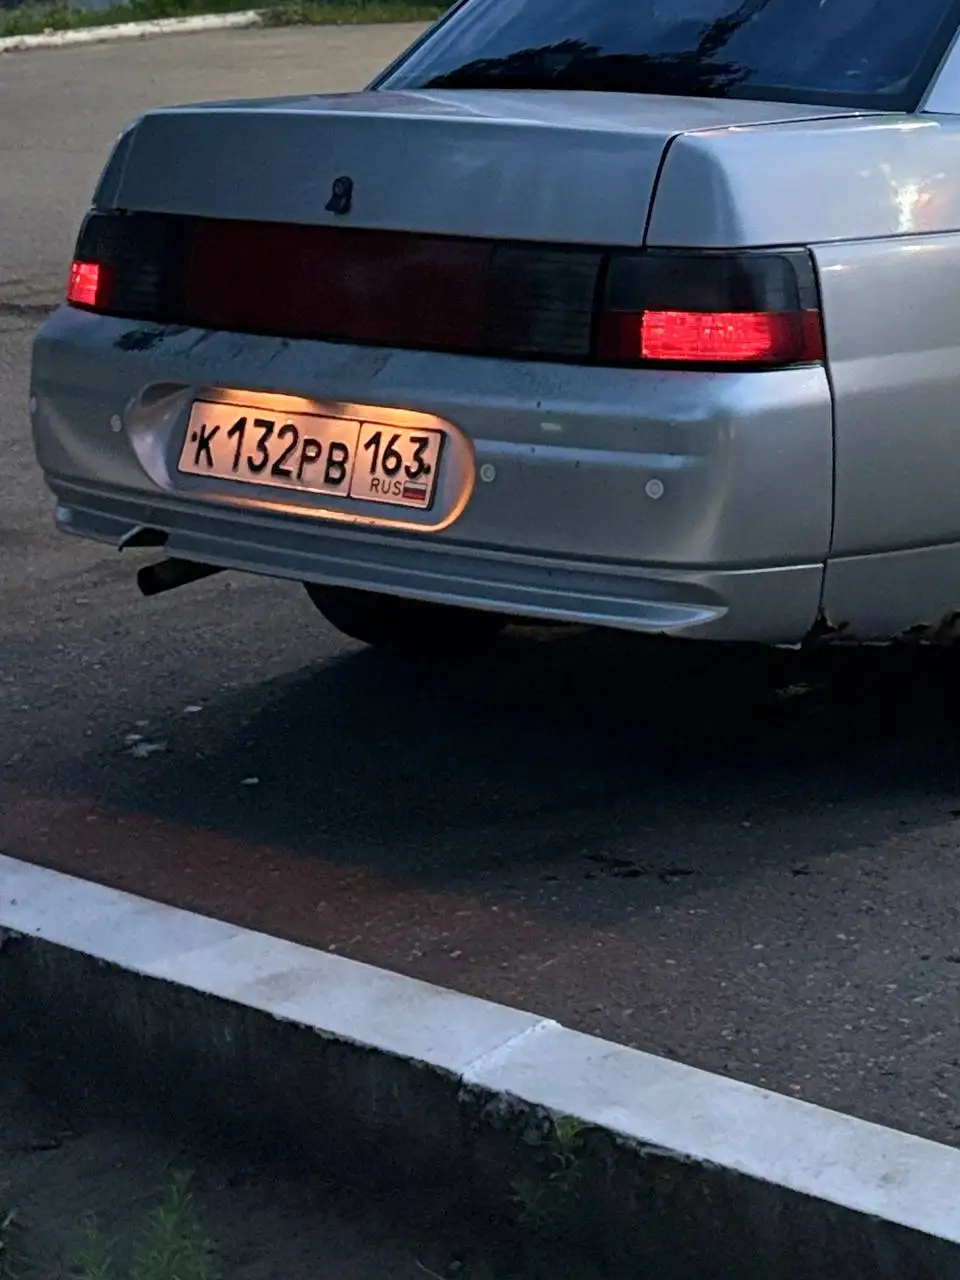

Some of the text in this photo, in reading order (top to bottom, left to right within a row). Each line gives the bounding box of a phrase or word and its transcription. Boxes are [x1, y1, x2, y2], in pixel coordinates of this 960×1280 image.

[193, 417, 430, 486] К132РВ 163
[370, 477, 402, 496] RUS
